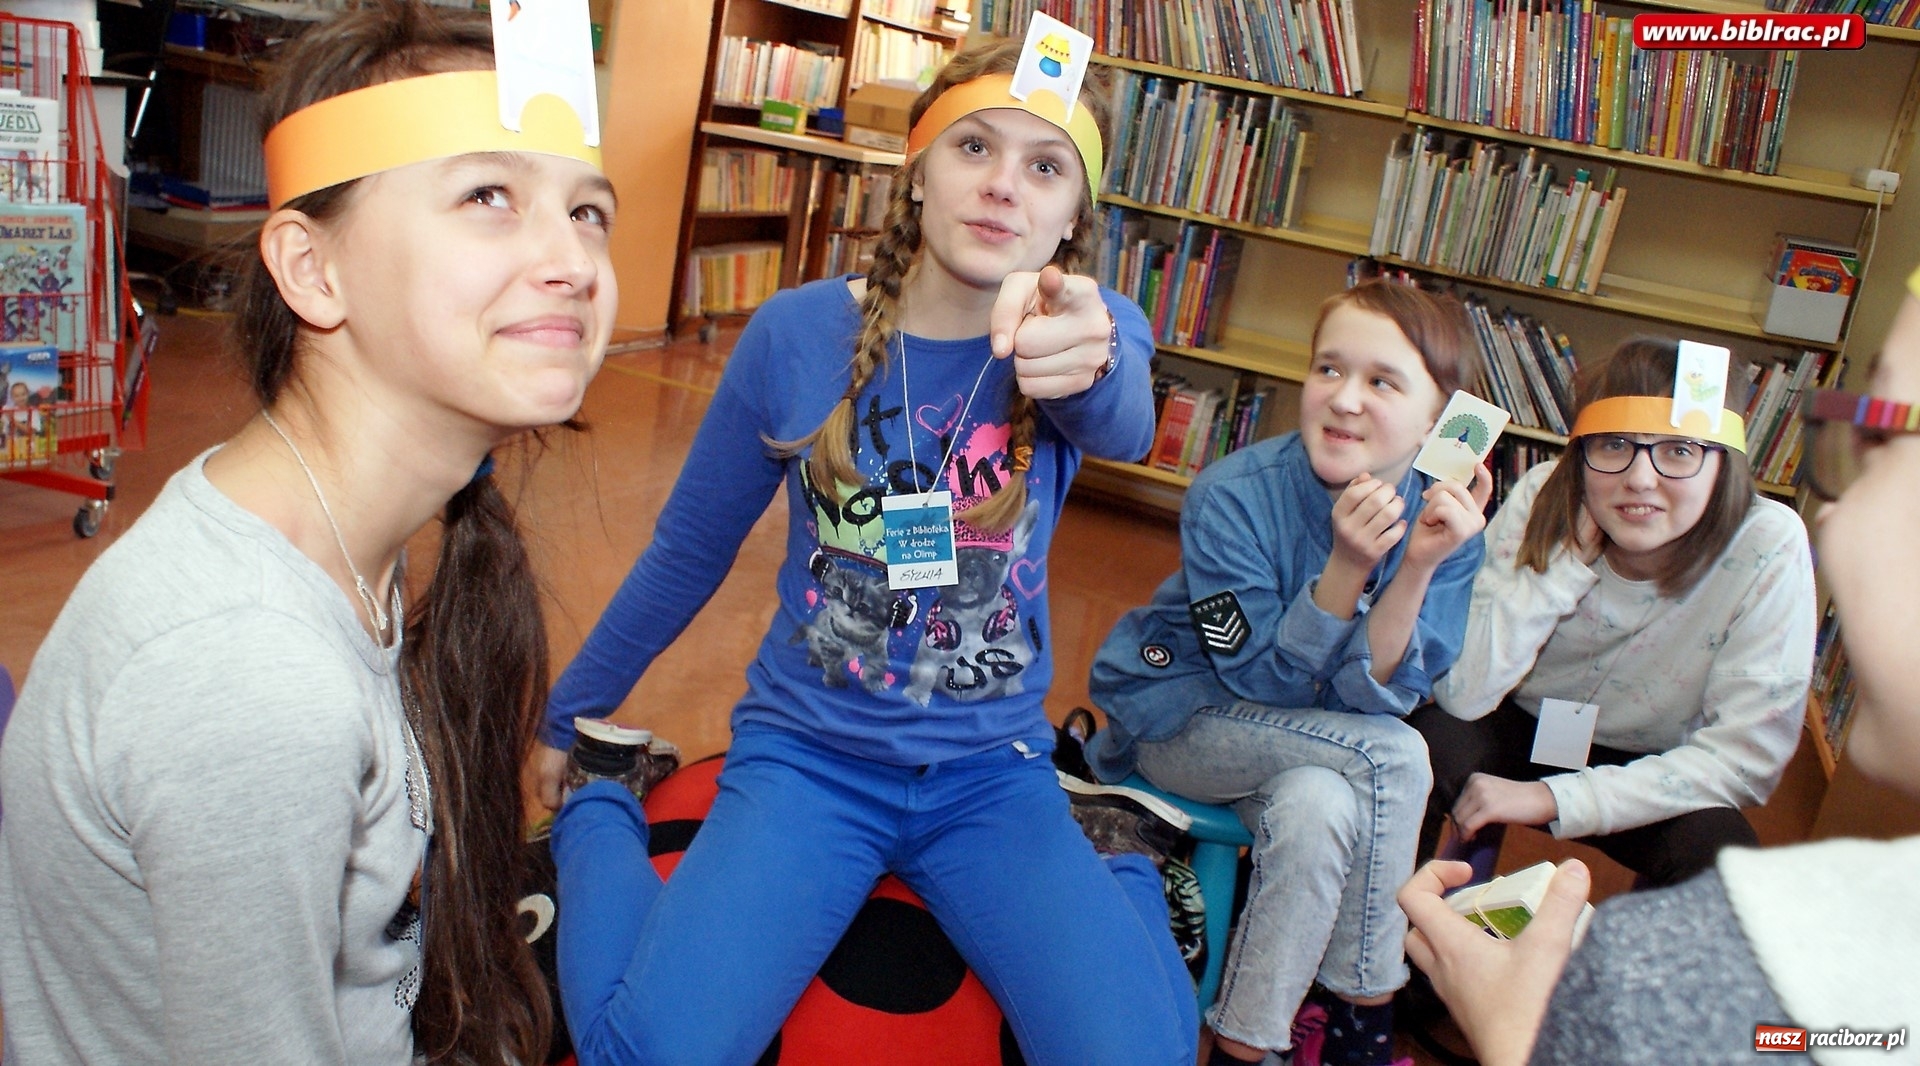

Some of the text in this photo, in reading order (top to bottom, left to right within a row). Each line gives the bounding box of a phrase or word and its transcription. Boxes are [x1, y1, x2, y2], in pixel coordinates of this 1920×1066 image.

[49, 226, 73, 239] LAS
[886, 528, 904, 537] Ferie
[898, 538, 936, 548] W drodze
[914, 550, 937, 560] Olimp
